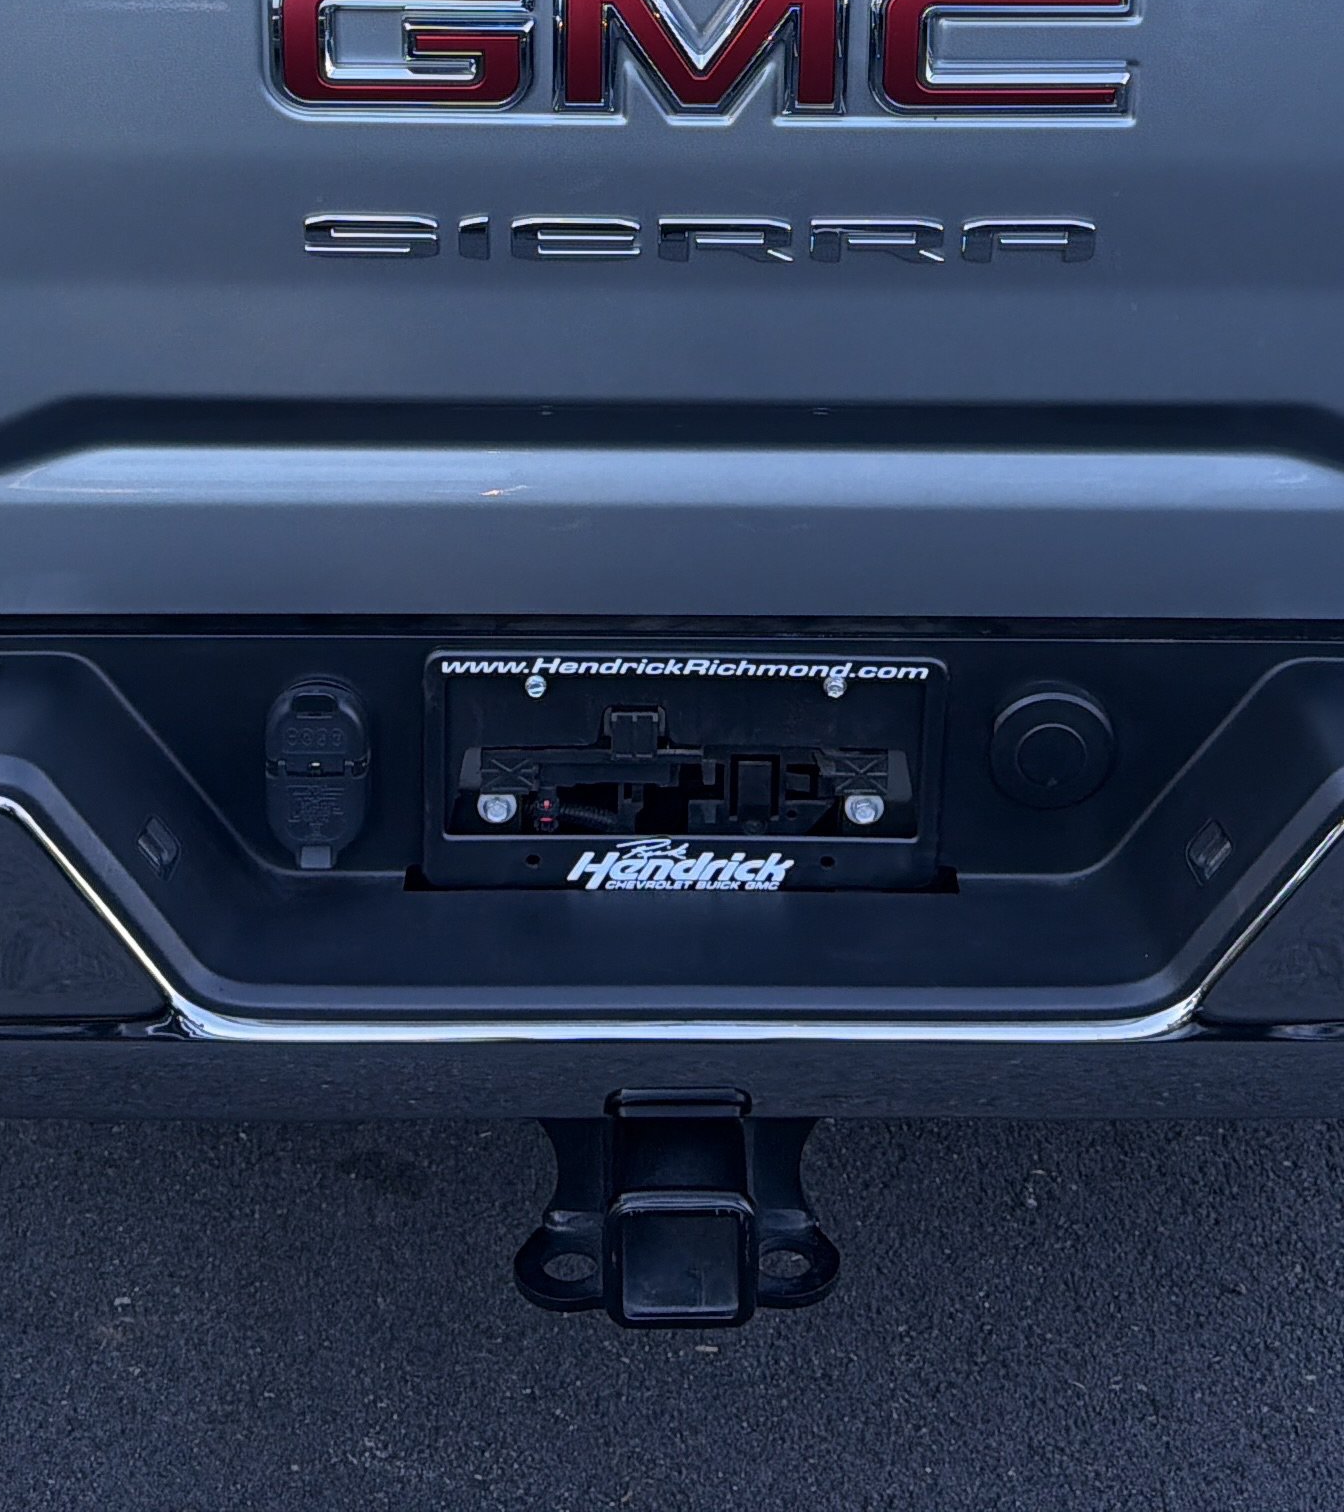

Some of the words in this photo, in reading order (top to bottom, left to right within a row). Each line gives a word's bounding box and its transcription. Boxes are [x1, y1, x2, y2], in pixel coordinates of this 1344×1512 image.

[302, 212, 1096, 264] SIERRA
[441, 656, 930, 681] www.HendrickRichmond.com
[566, 851, 795, 890] Hendrick
[604, 880, 694, 890] CHEVROLET
[694, 881, 742, 891] BUICK
[744, 881, 780, 891] GMC
